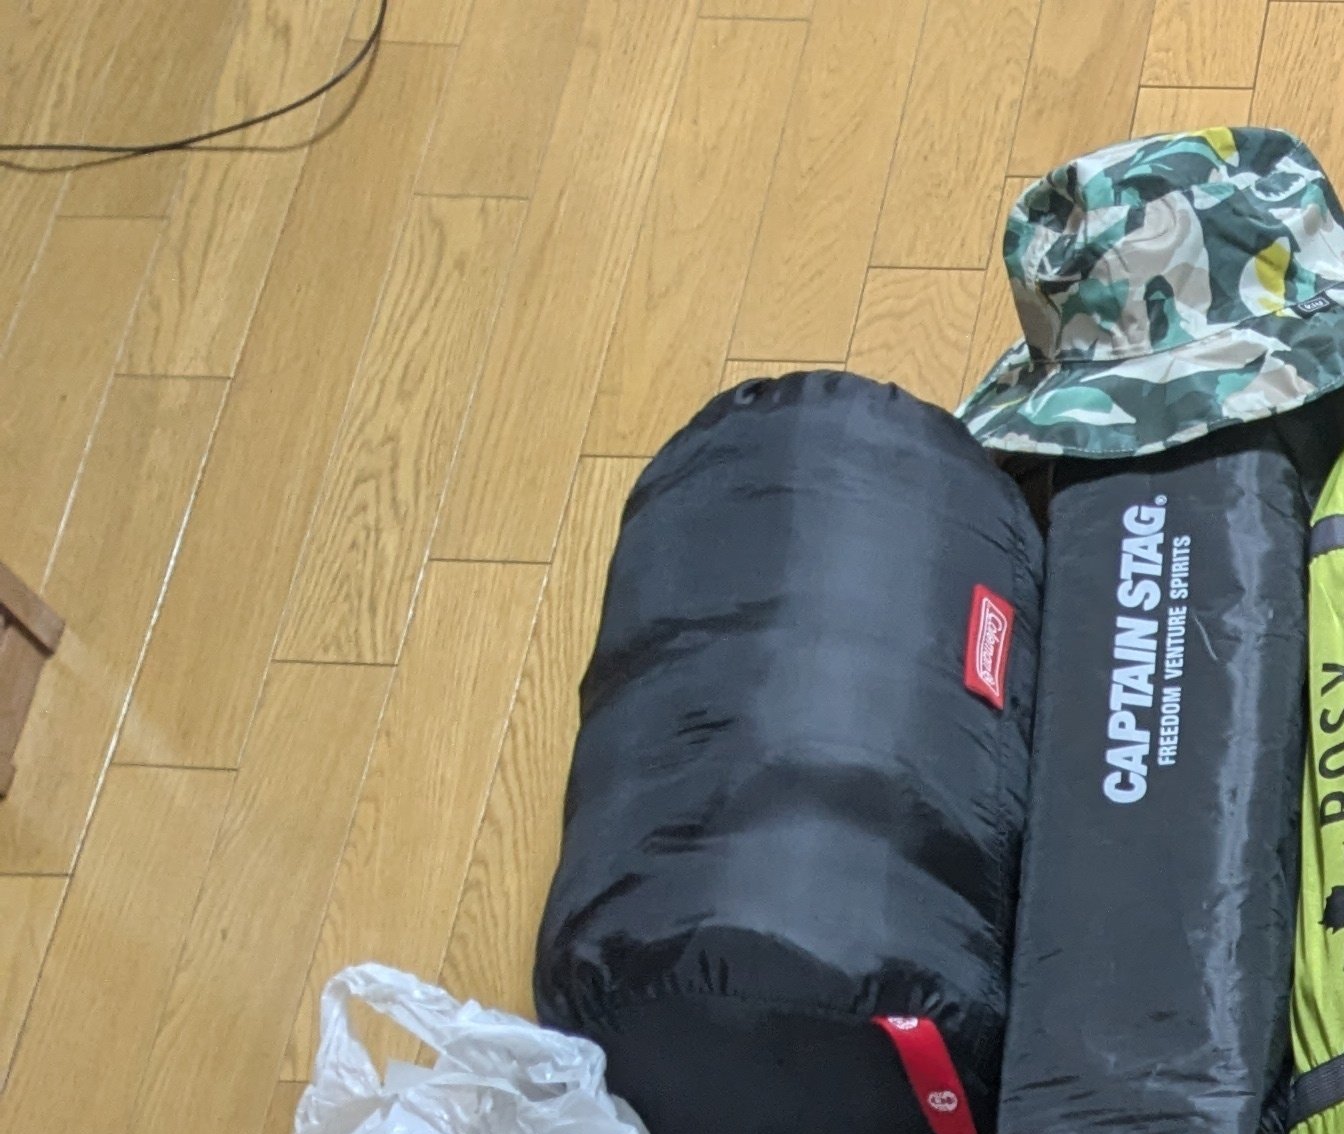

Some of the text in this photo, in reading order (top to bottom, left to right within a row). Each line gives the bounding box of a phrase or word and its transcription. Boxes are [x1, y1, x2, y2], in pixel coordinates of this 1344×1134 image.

[1103, 616, 1159, 803] CAPTAIN
[1158, 535, 1191, 766] FREEDOM VENTURE SPIRITS
